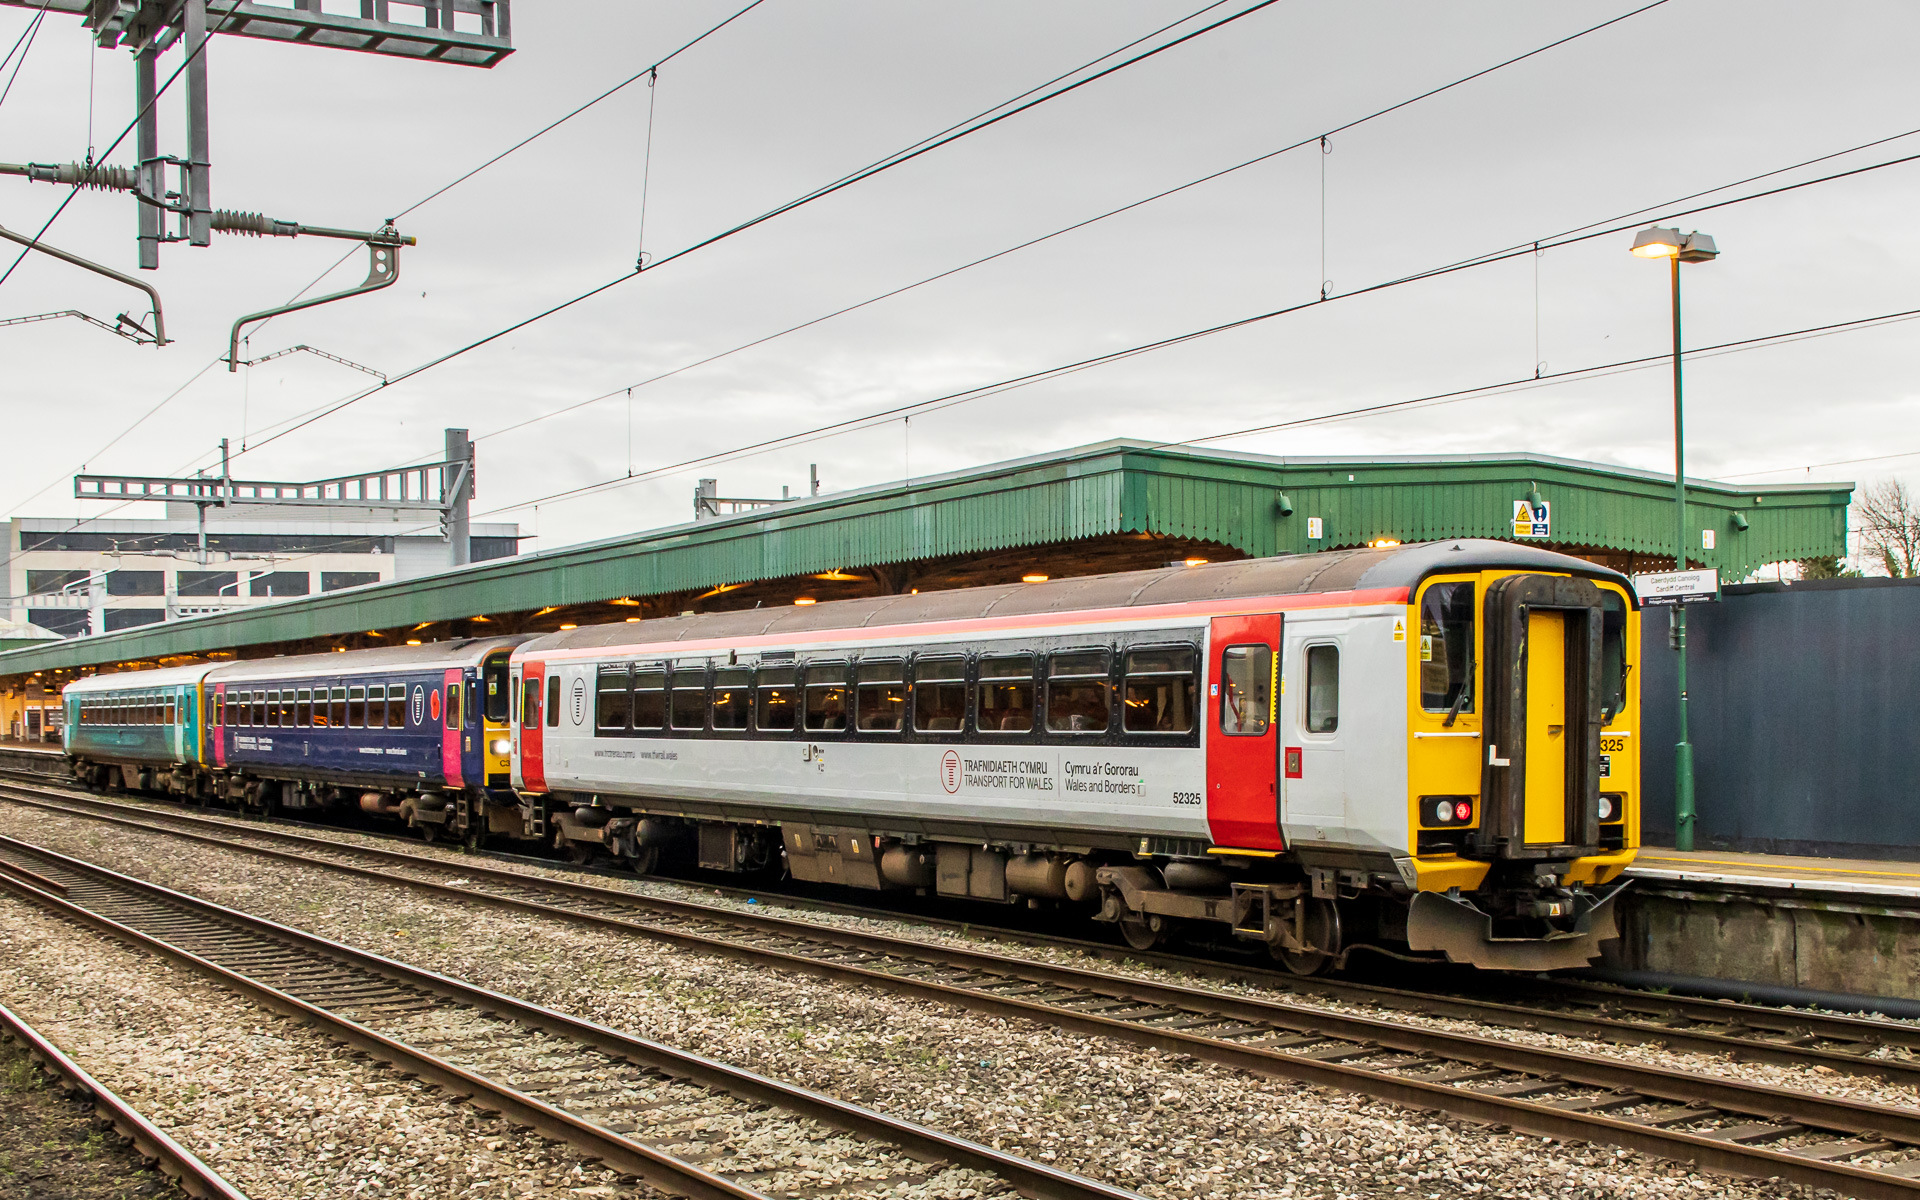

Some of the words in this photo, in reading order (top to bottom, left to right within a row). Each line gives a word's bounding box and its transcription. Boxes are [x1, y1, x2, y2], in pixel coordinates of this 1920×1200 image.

[1650, 576, 1677, 584] Caerdydd
[1600, 739, 1624, 752] 325
[964, 760, 1018, 774] TRAFNIDIAETH
[1019, 761, 1048, 775] CYMRU
[1065, 761, 1091, 777] Cymru
[1092, 761, 1103, 775] a'r
[1104, 762, 1139, 777] Gororau
[964, 774, 1008, 789] TRANSPORT
[1009, 776, 1025, 789] FOR
[1026, 777, 1054, 791] WALES
[1065, 778, 1088, 792] Wales
[1088, 780, 1103, 793] and
[1104, 780, 1136, 794] Borders
[1172, 791, 1202, 805] 52325
